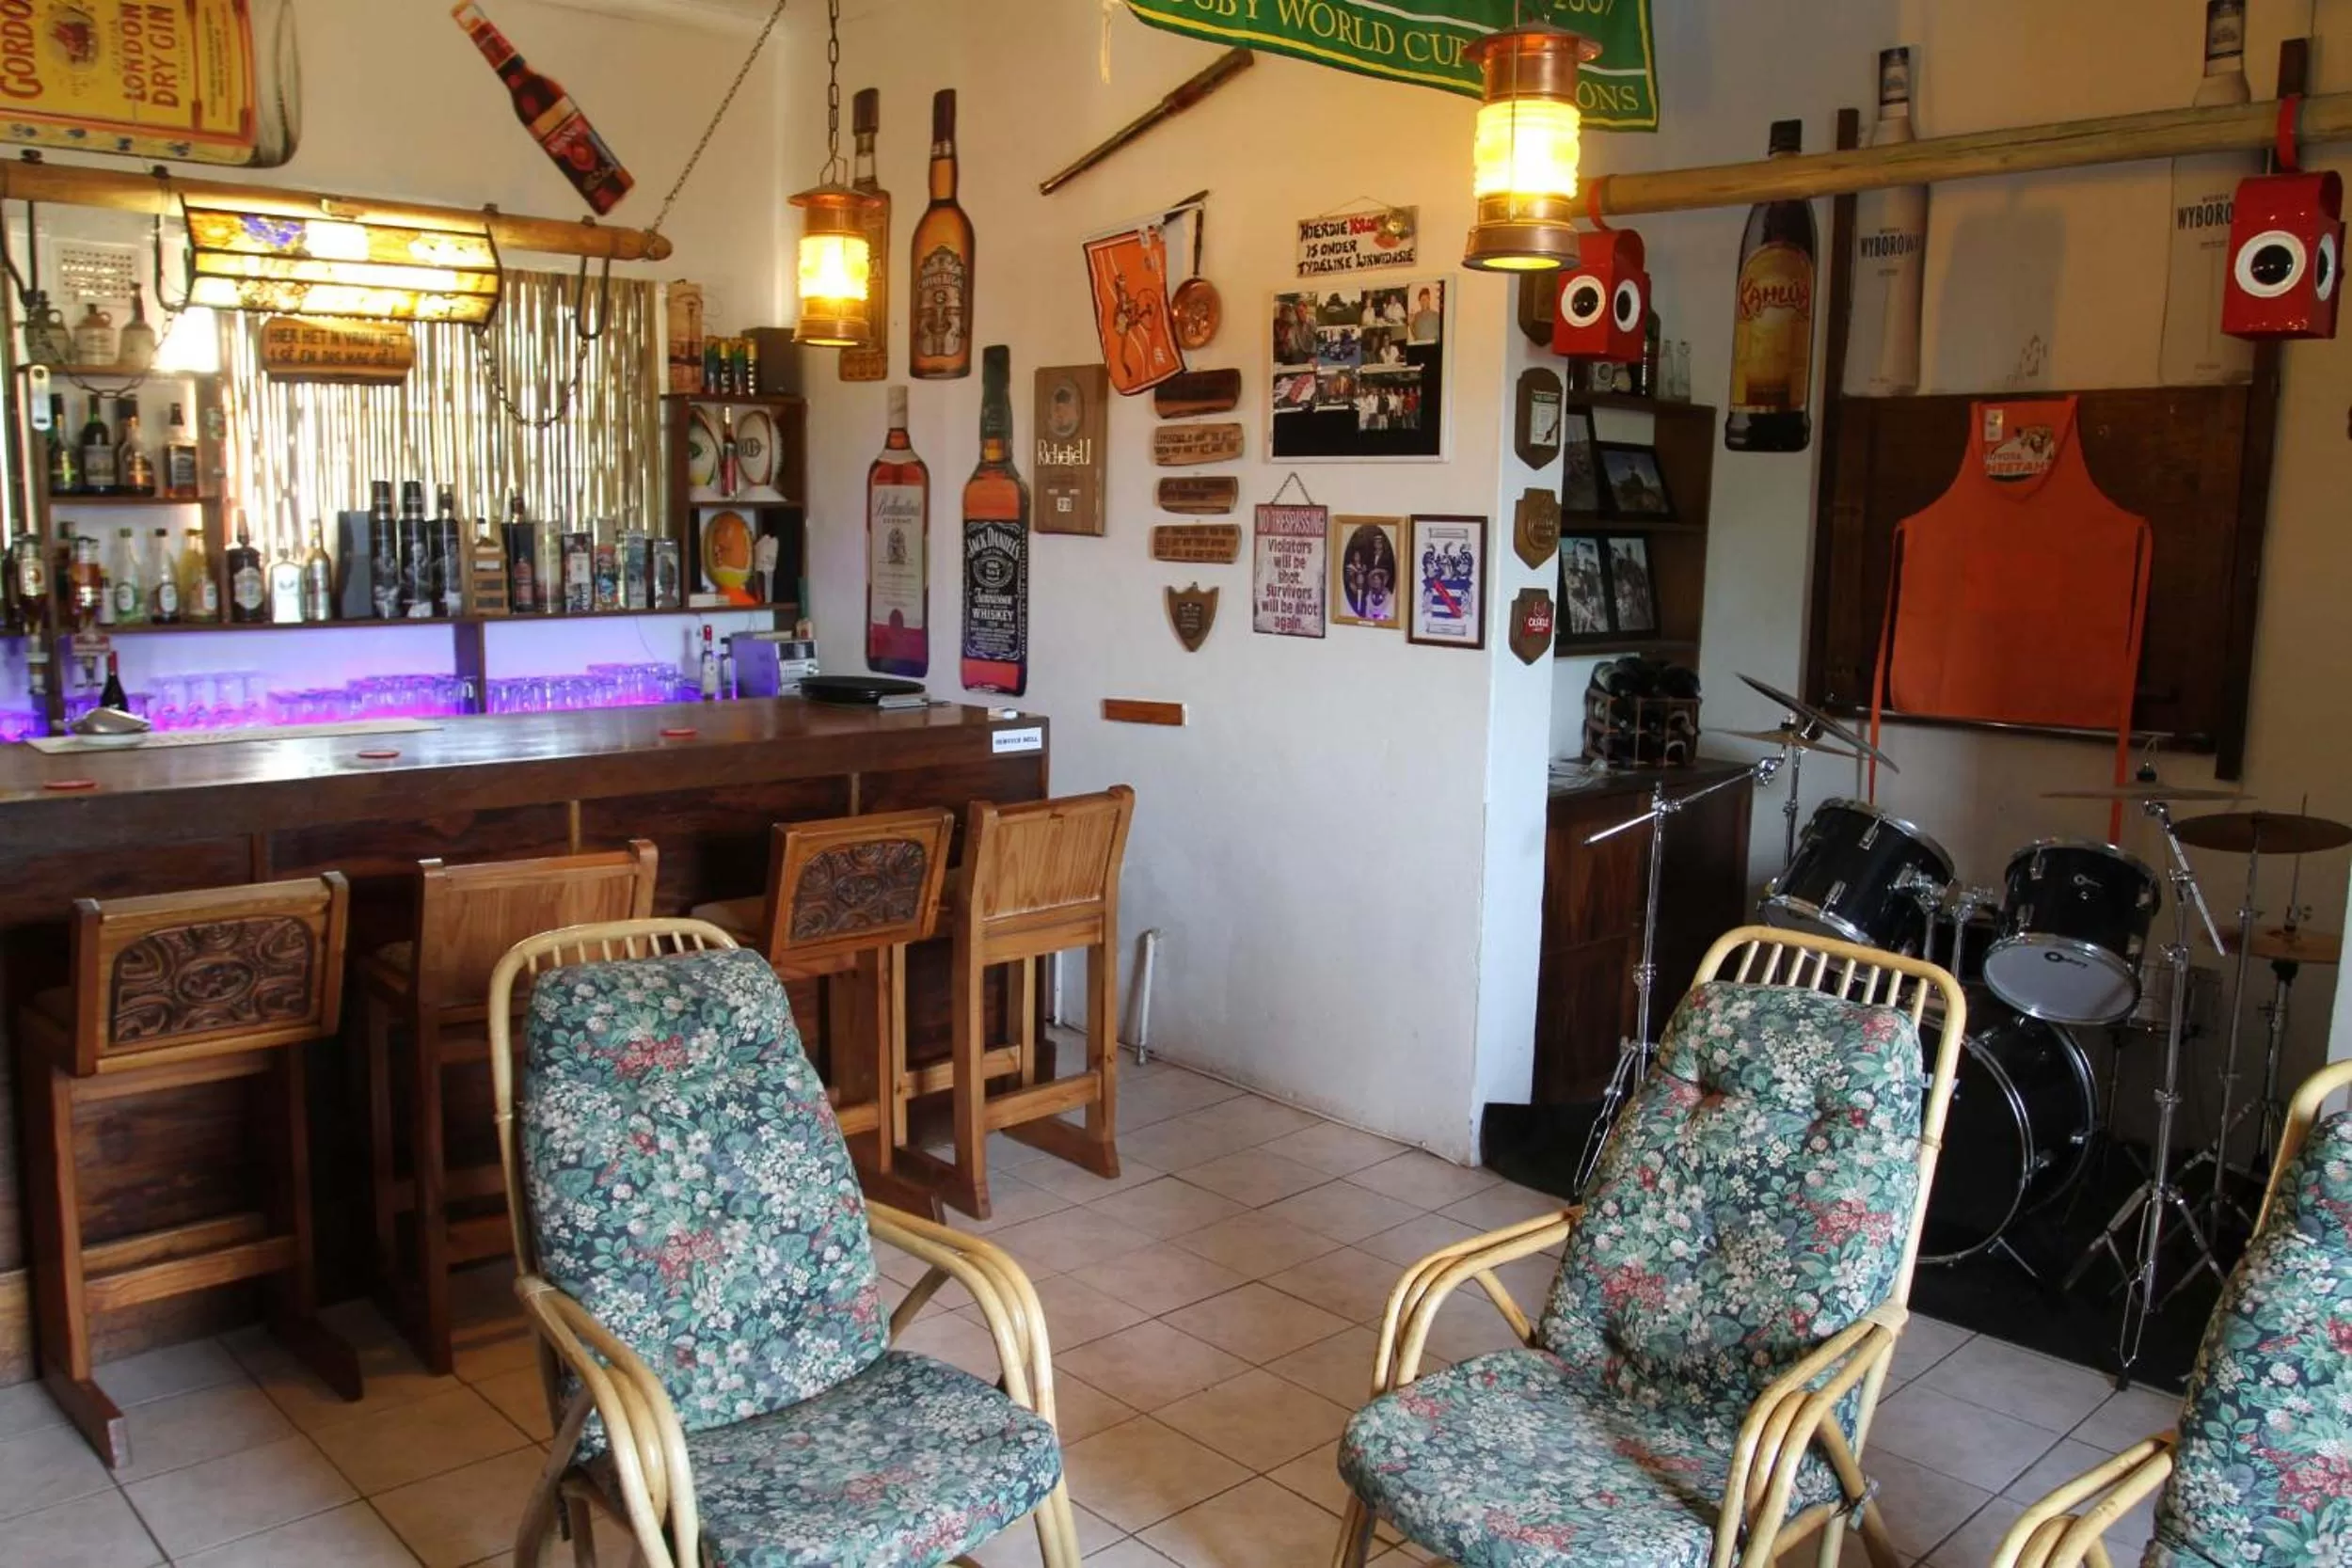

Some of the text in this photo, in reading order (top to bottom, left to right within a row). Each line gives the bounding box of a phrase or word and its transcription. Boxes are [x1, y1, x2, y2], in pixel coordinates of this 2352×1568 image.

[1278, 0, 1394, 55] WORLD
[119, 2, 147, 102] LONDON
[146, 4, 180, 108] DRY GIN
[2177, 201, 2234, 230] WYBORO
[1307, 240, 1357, 258] IS ONDER
[1267, 538, 1312, 554] Violators
[1266, 583, 1312, 599] Survivors
[972, 608, 1013, 622] WHISKEY
[1262, 599, 1318, 616] will be shot
